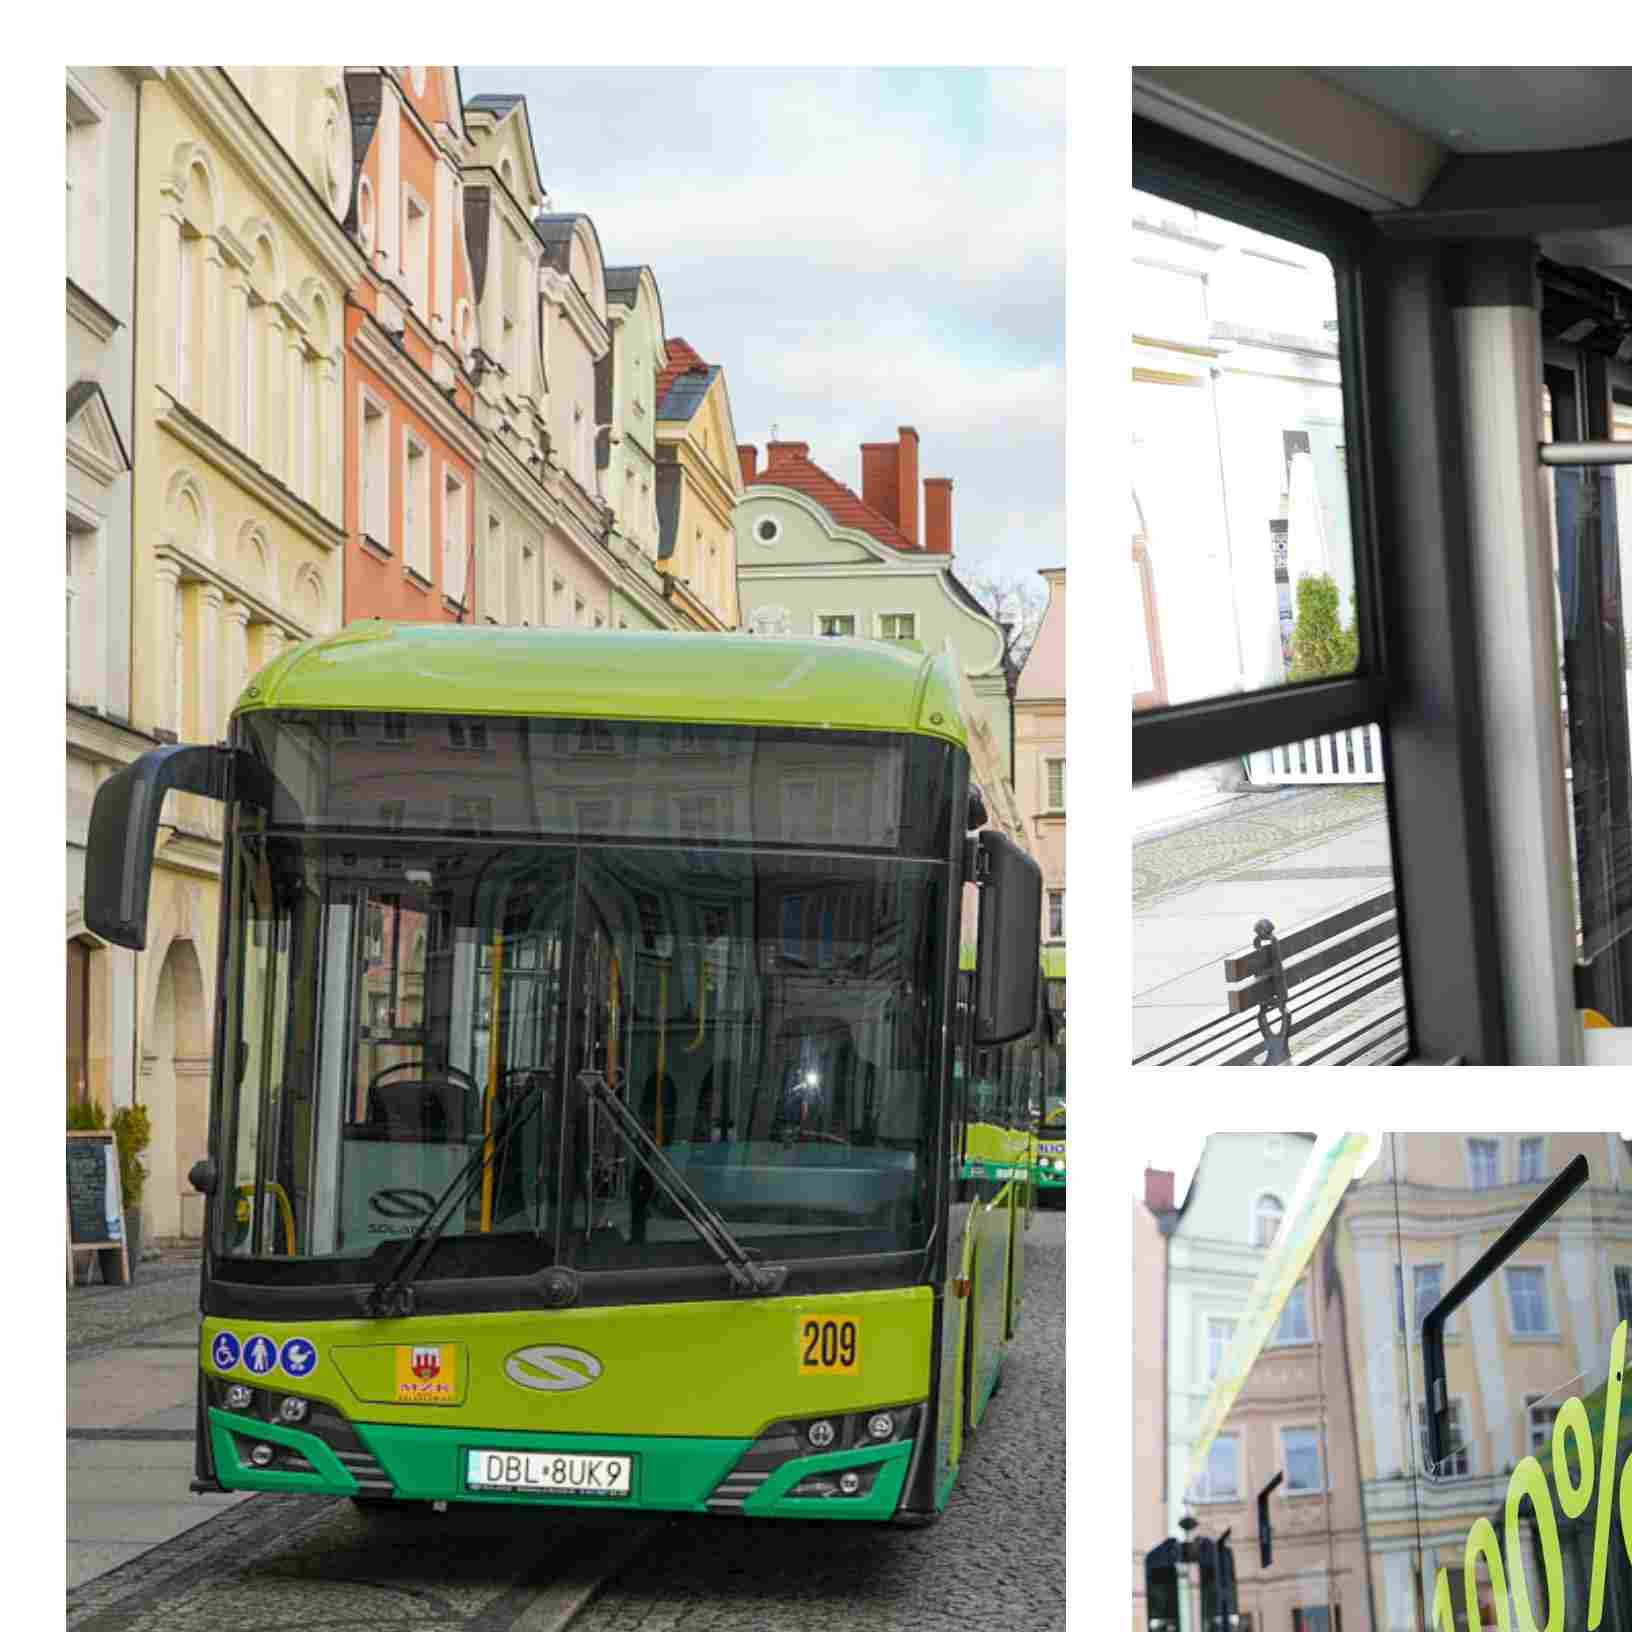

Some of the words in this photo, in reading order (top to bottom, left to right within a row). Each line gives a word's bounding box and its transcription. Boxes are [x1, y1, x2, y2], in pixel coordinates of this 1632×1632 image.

[803, 1321, 856, 1366] 209
[486, 1455, 539, 1484] DBL
[551, 1458, 622, 1486] 8UK9
